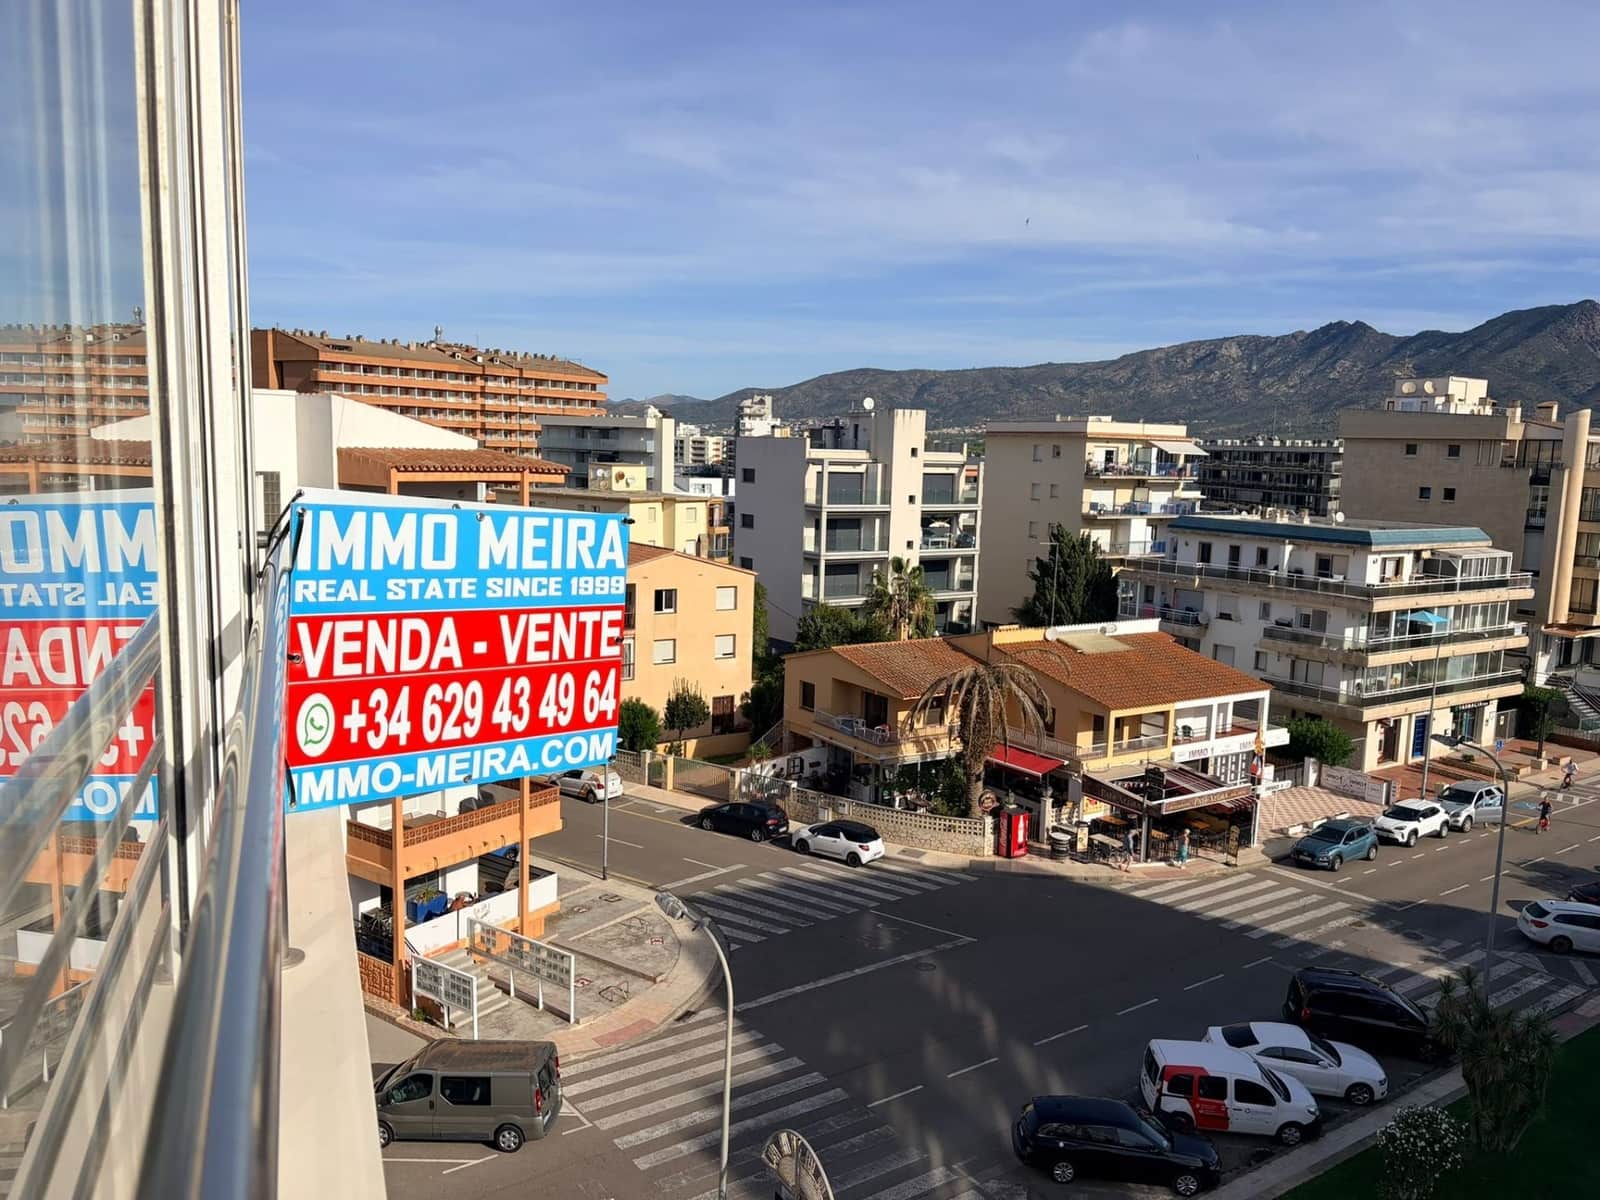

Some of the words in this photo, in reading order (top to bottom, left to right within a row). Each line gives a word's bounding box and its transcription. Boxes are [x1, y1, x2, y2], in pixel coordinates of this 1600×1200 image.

[296, 509, 458, 571] IMMO
[478, 515, 626, 570] MEIRA
[294, 578, 376, 603] REAL
[386, 576, 478, 601] STATE
[486, 575, 562, 599] SINCE
[570, 574, 625, 596] 1999
[297, 616, 463, 679] VENDA
[473, 640, 488, 654] -
[499, 609, 622, 664] VENTE
[343, 685, 411, 750] +34
[421, 679, 483, 744] 629
[492, 675, 530, 734] 43
[538, 671, 576, 728] 49
[583, 667, 617, 725] 64
[288, 732, 613, 805] IMMO-MEIRA.COM
